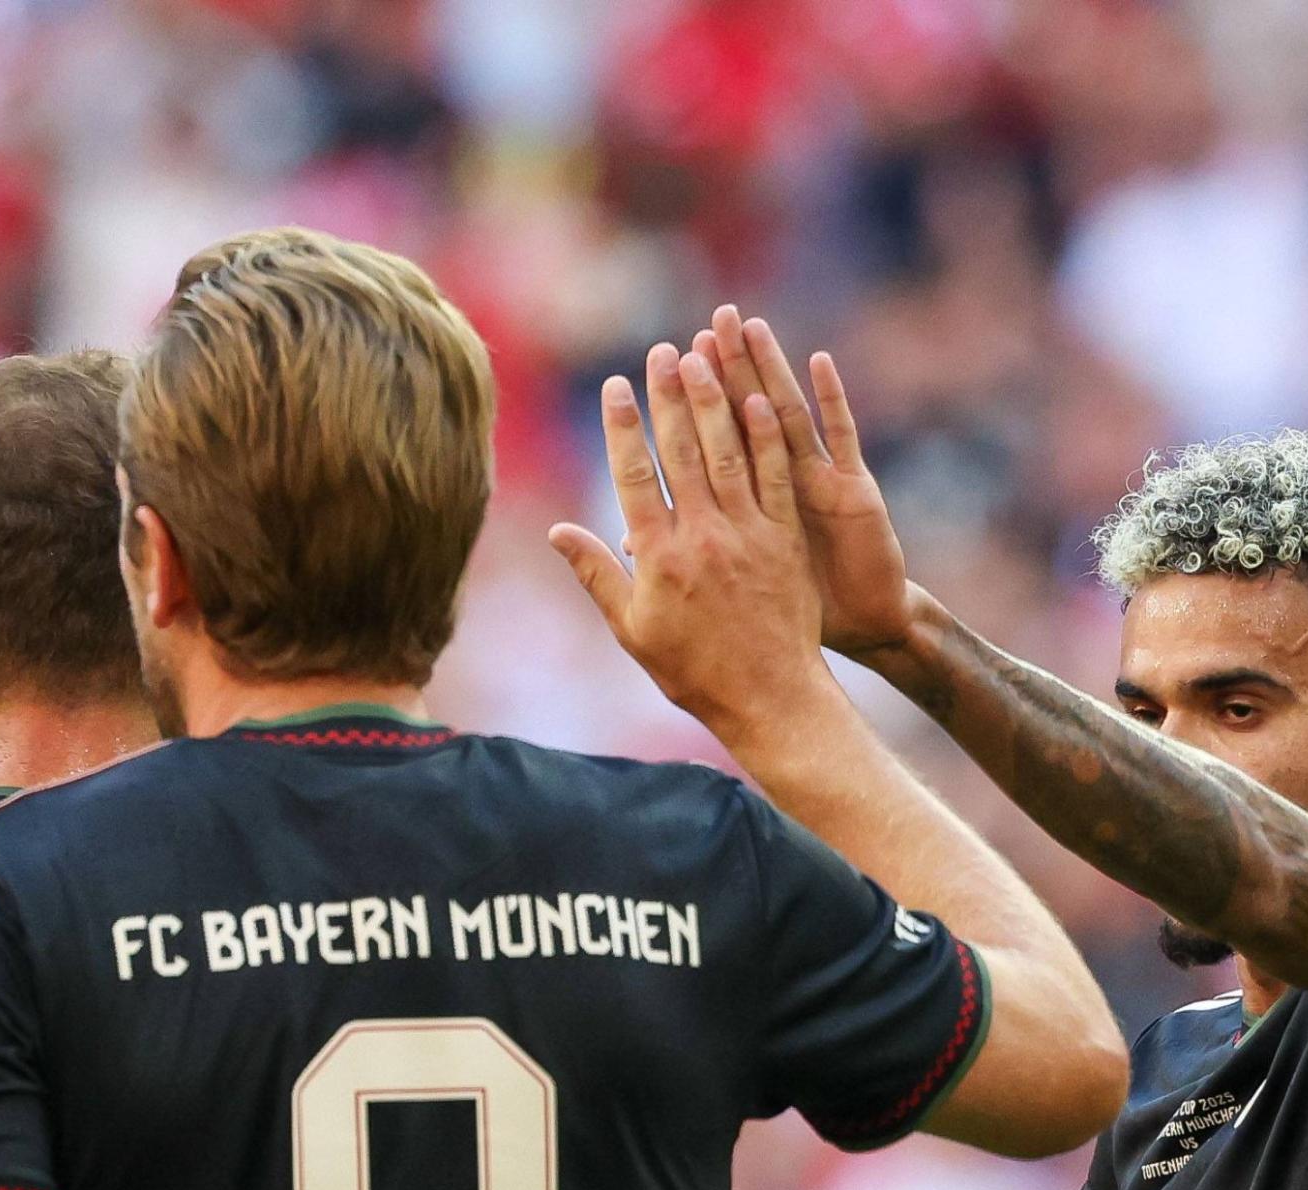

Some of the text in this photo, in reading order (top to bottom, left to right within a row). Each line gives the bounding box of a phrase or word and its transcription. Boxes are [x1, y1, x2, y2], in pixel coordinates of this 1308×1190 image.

[112, 892, 702, 981] FC BAYERN MÜNCHEN
[1198, 1091, 1235, 1111] 2025
